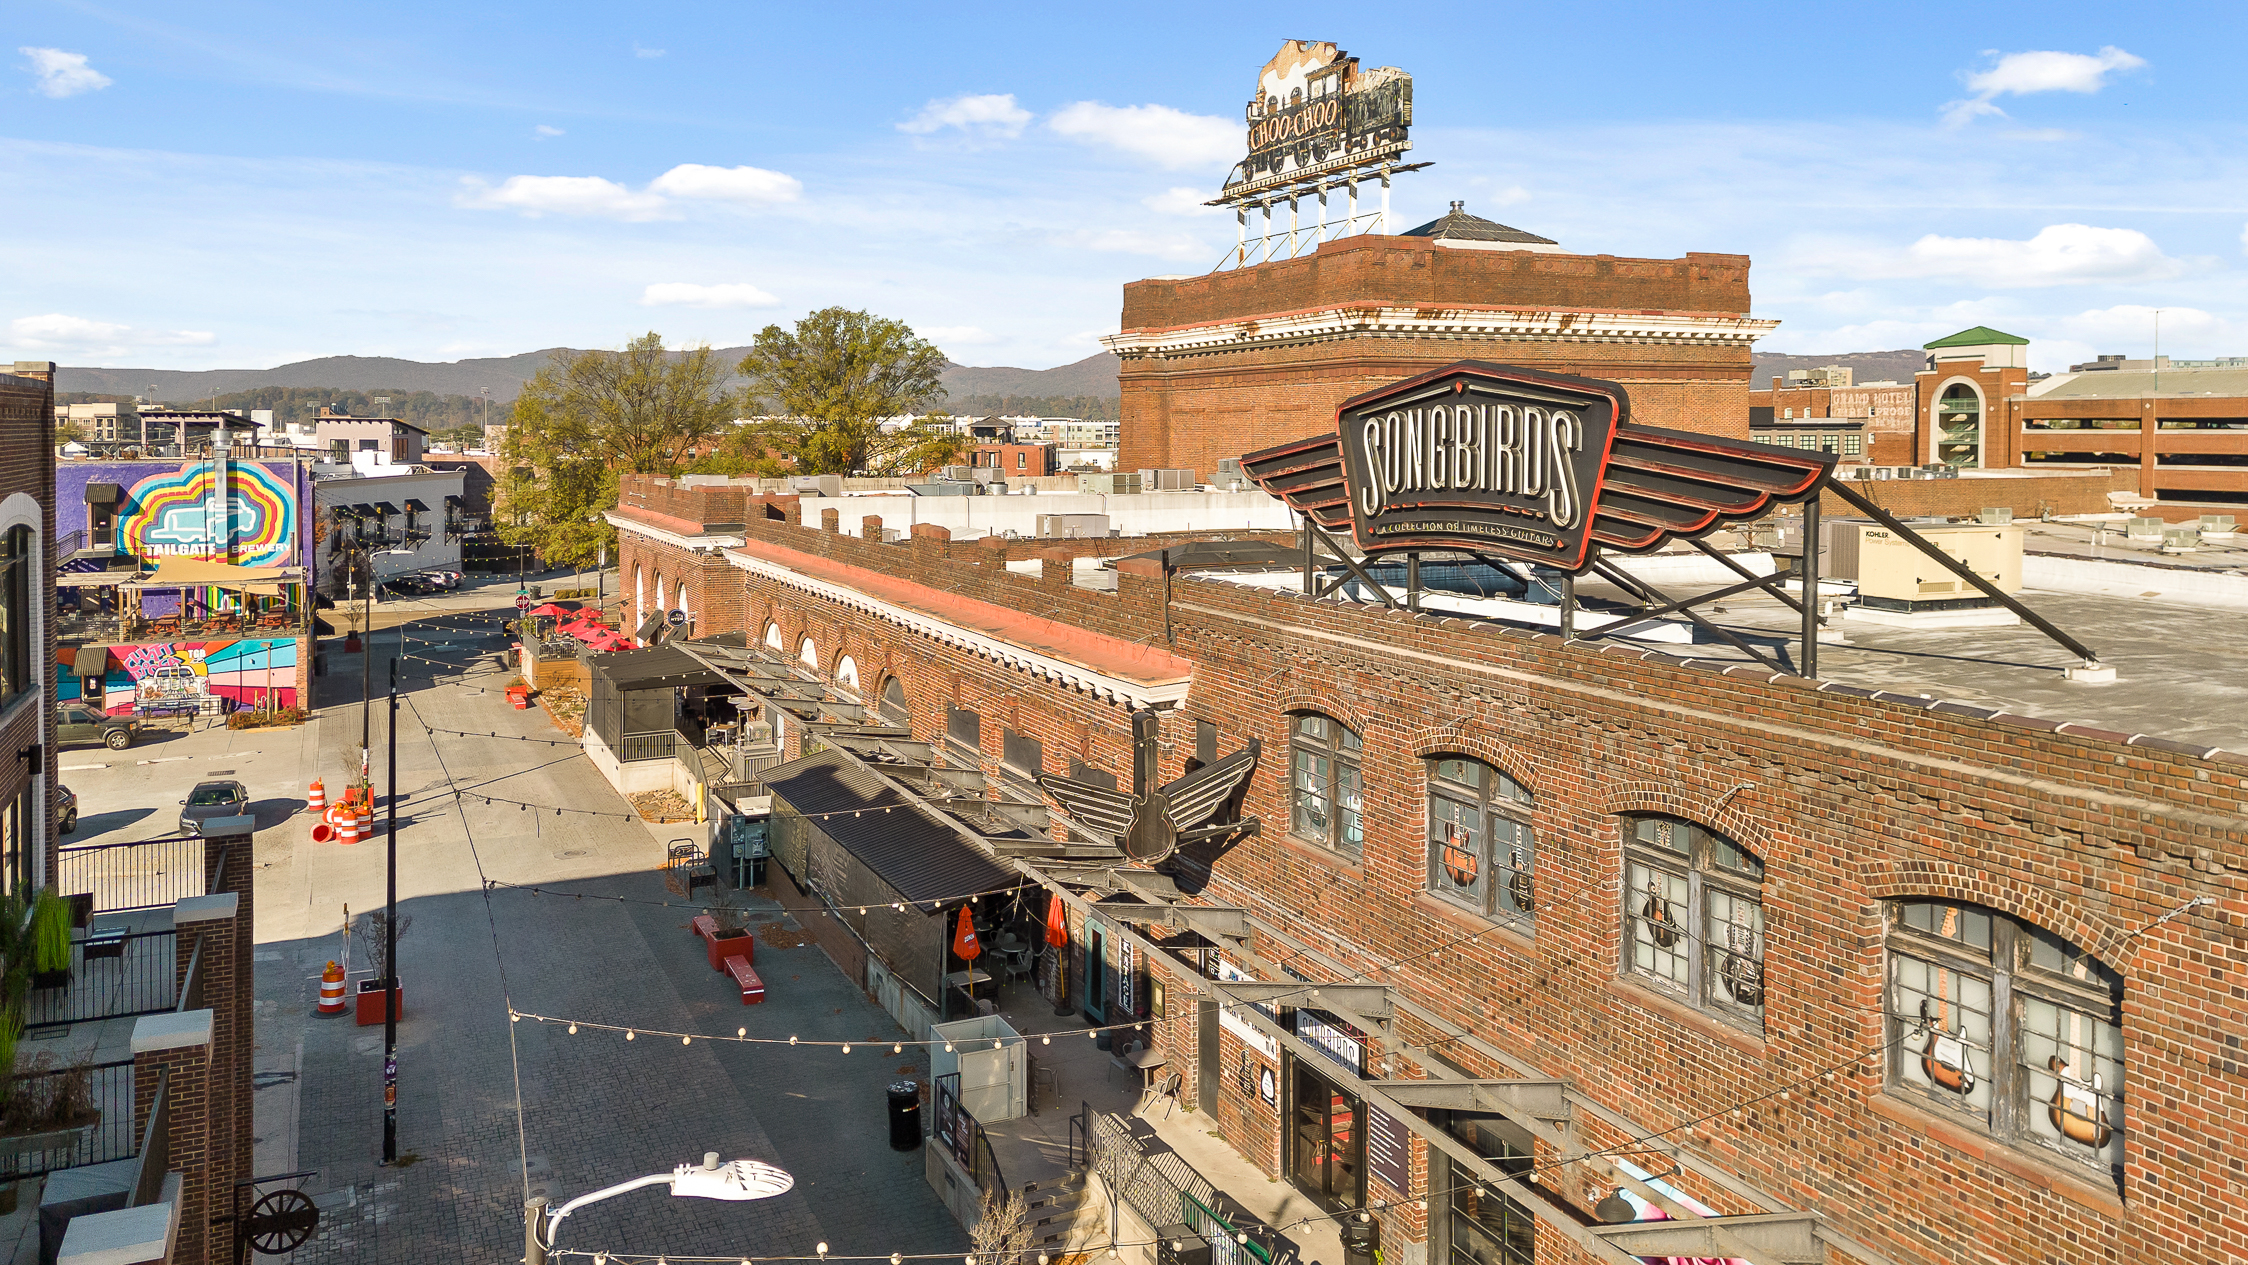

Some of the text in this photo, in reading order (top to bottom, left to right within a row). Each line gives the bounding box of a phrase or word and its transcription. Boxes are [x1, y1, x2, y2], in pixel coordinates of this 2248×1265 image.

[1250, 99, 1338, 150] CHOO-CHOO
[1833, 391, 1911, 405] GRAND HOTEL
[1362, 403, 1580, 529] SONGBIRDS
[1389, 522, 1444, 533] COLLECTION
[1462, 523, 1507, 536] TIMELESS
[1510, 530, 1554, 545] GUITARS
[1865, 538, 1883, 546] Power
[144, 542, 291, 556] TAILGATE BREWERY
[1302, 1016, 1355, 1076] SONGBIRDS
